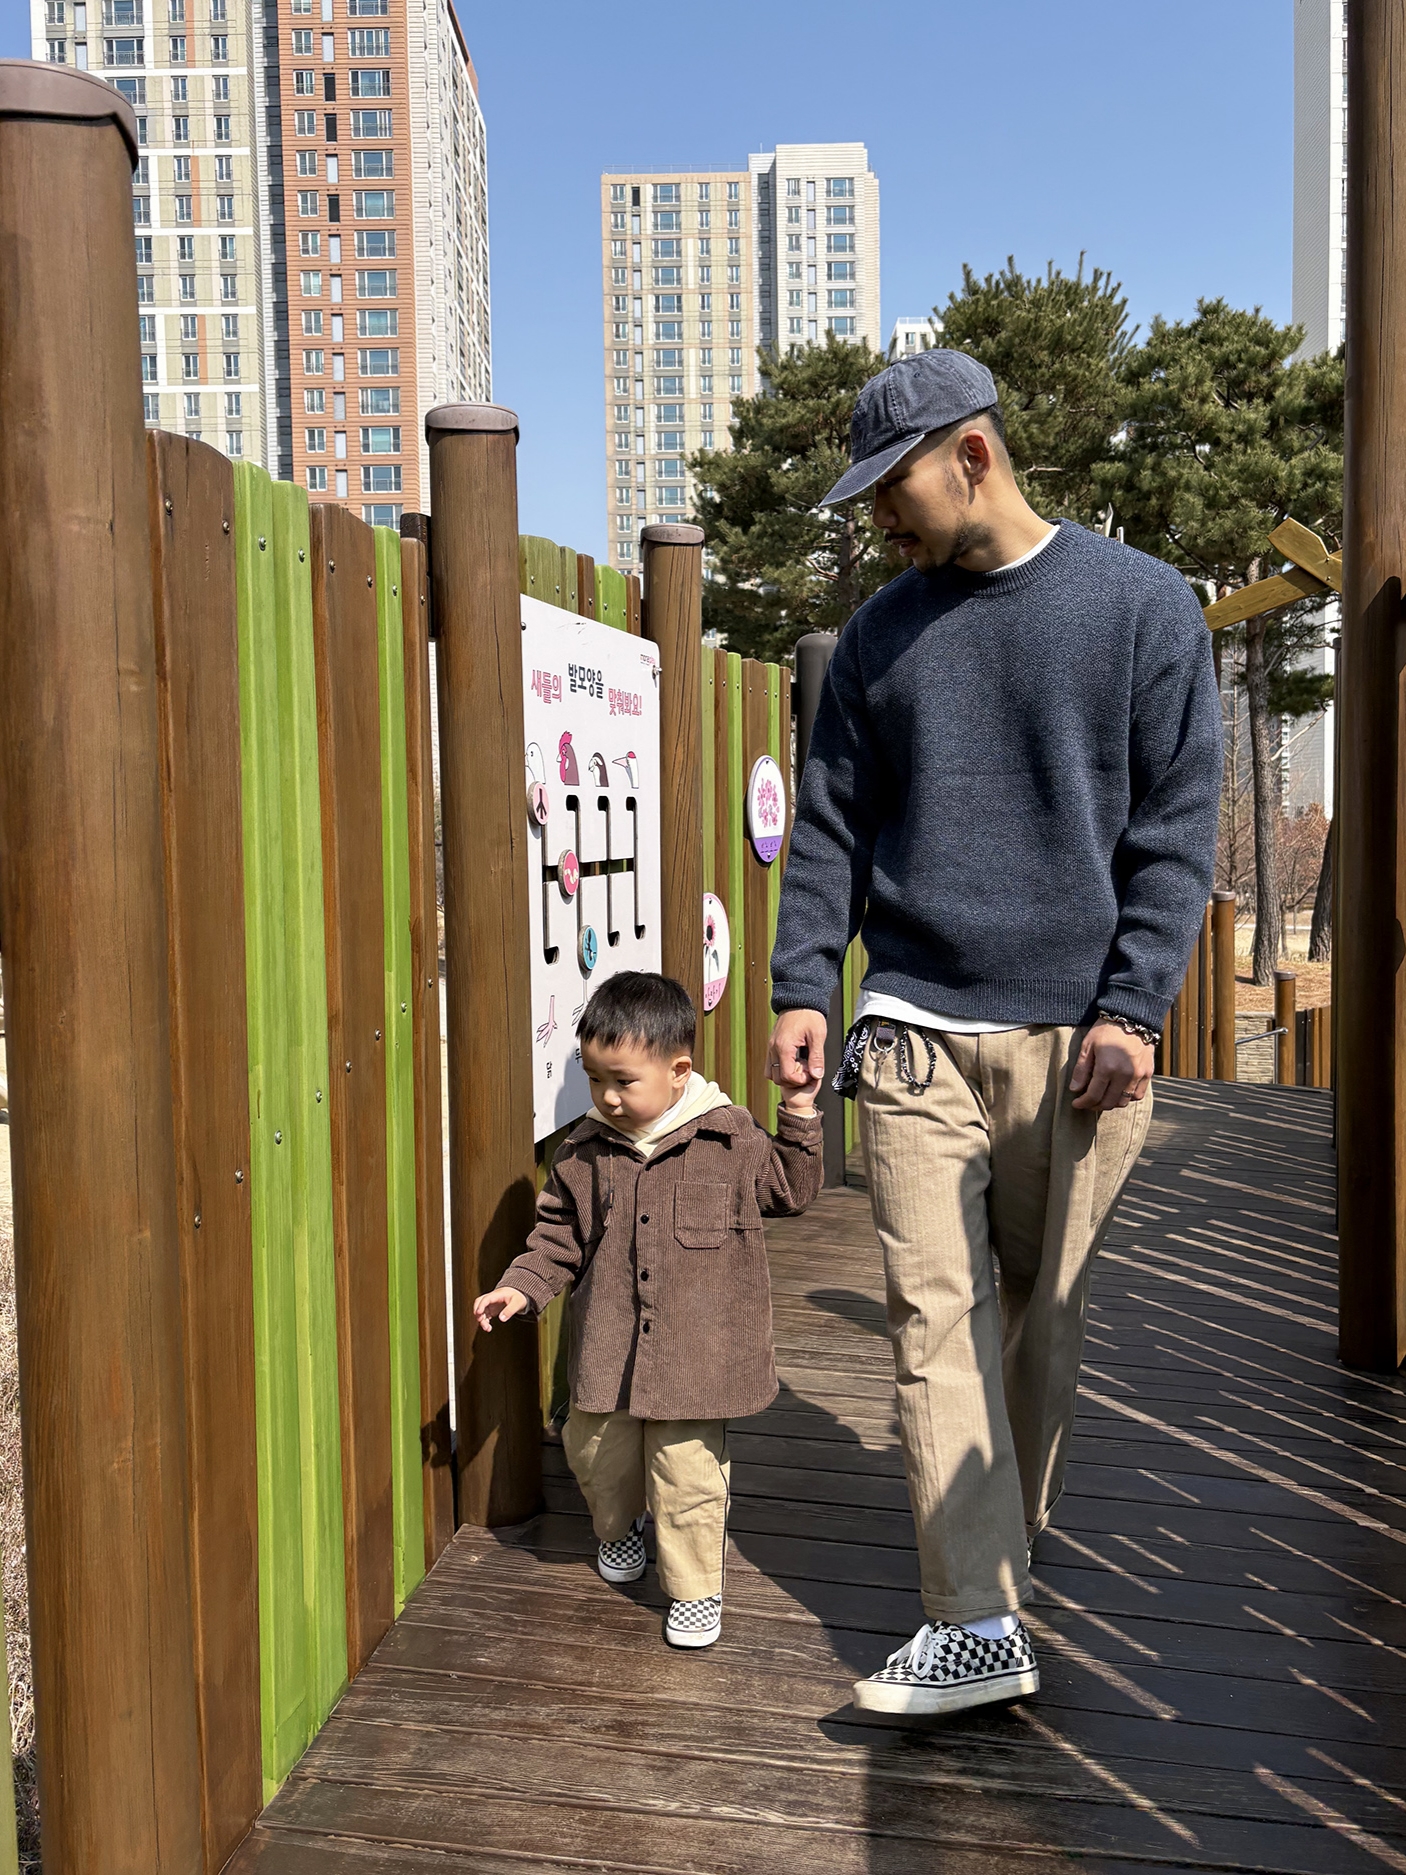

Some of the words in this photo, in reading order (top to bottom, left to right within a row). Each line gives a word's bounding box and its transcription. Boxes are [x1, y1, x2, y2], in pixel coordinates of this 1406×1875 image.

[531, 669, 562, 704] 새들의
[568, 663, 604, 699] 발모양을
[608, 688, 642, 716] 맞춰봐요!
